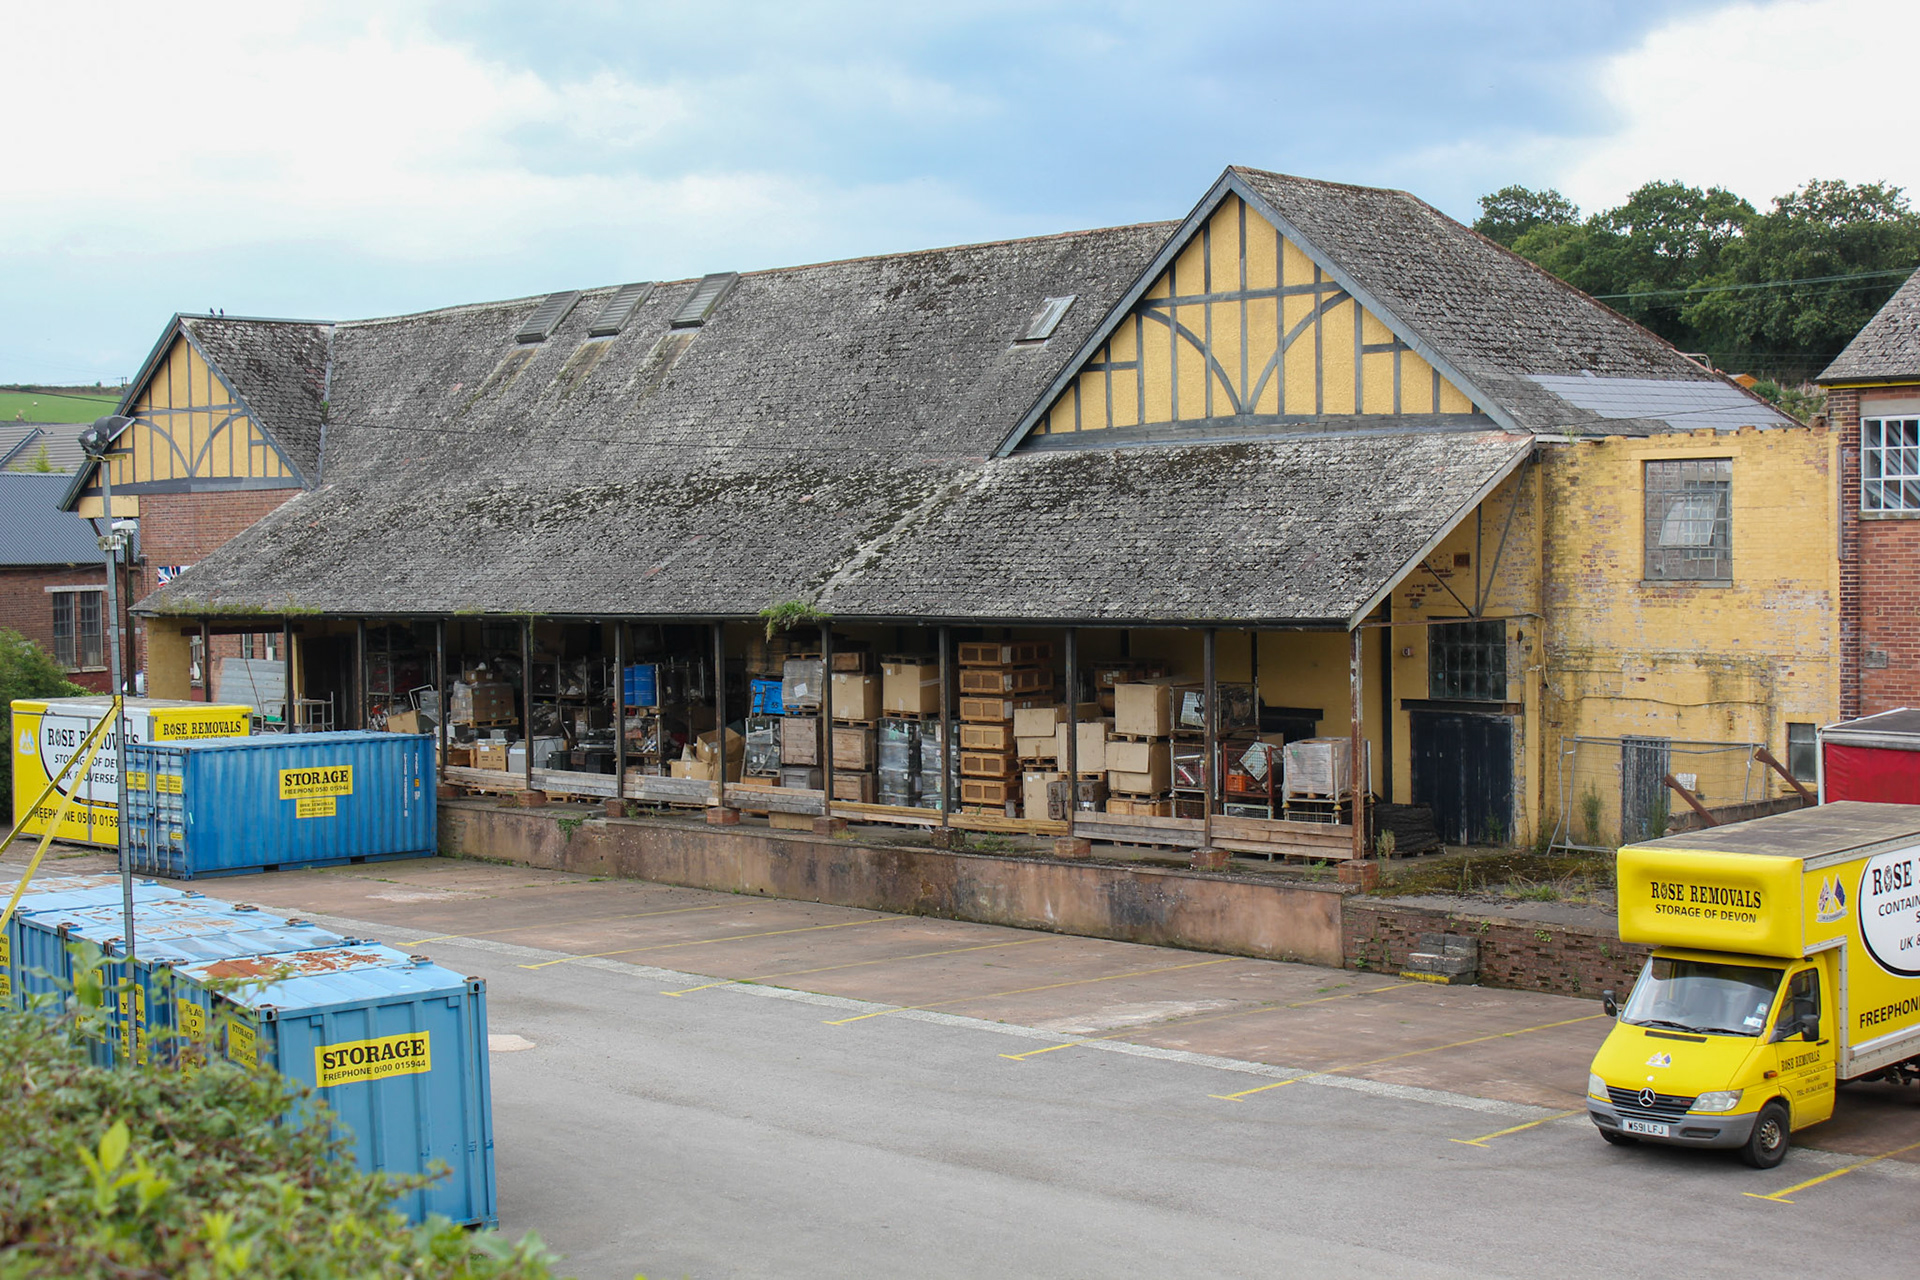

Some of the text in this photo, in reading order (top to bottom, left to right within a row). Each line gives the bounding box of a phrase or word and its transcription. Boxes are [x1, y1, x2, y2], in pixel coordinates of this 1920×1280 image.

[47, 728, 75, 748] ROSE
[163, 721, 241, 735] ROSE REMOVALS
[285, 770, 348, 786] STORAGE
[77, 812, 97, 825] 0500
[1872, 860, 1912, 896] ROSE
[1650, 881, 1761, 909] ROSE REMOVALS
[1655, 903, 1757, 923] STORAGE OF DEVON
[1899, 936, 1913, 951] UK
[323, 1038, 425, 1070] STORAGE
[323, 1059, 426, 1081] FREEPHONE 0500 015944
